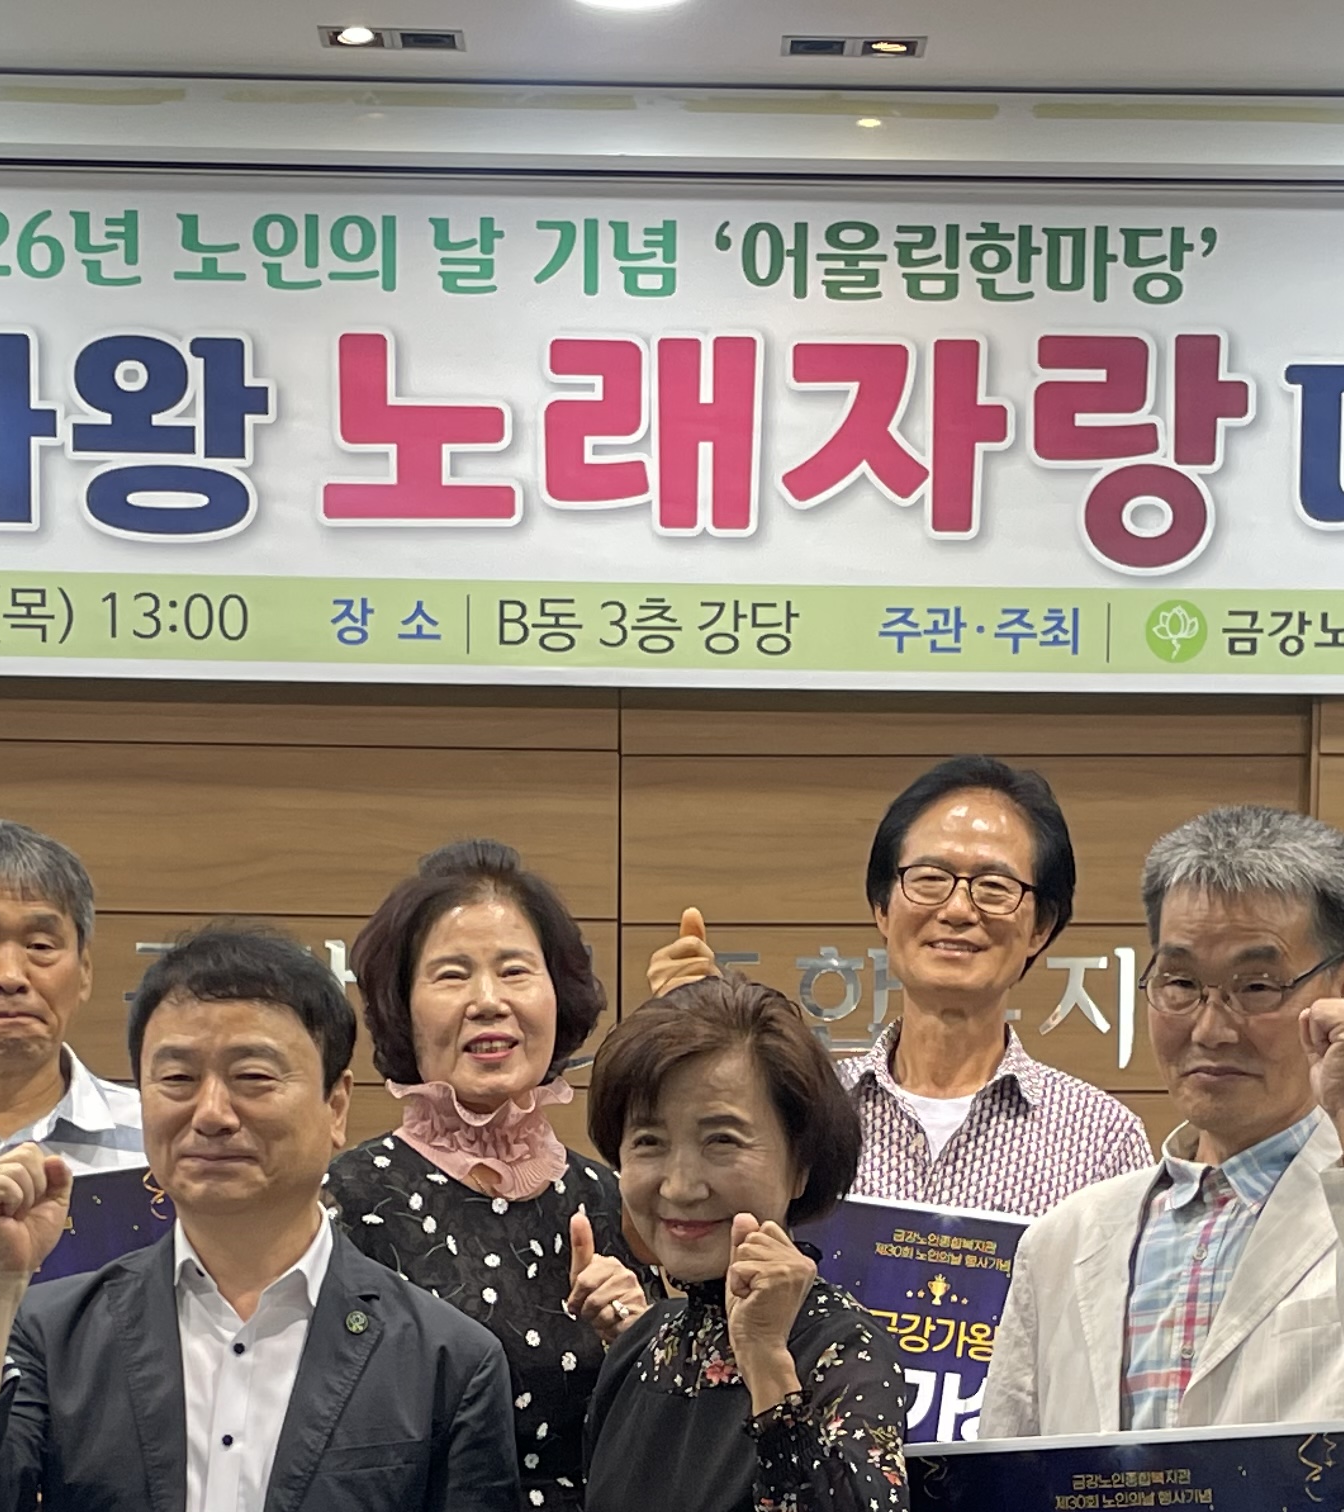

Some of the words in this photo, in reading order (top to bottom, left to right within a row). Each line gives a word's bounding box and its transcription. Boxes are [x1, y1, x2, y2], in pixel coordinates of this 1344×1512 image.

[173, 212, 397, 292] 노인의
[428, 215, 505, 295] 날
[534, 218, 677, 297] 기념
[320, 330, 1253, 570] 노래자랑
[100, 590, 250, 642] 13:00
[497, 597, 584, 654] B동
[598, 597, 684, 655] 3층
[696, 599, 800, 656] 강당
